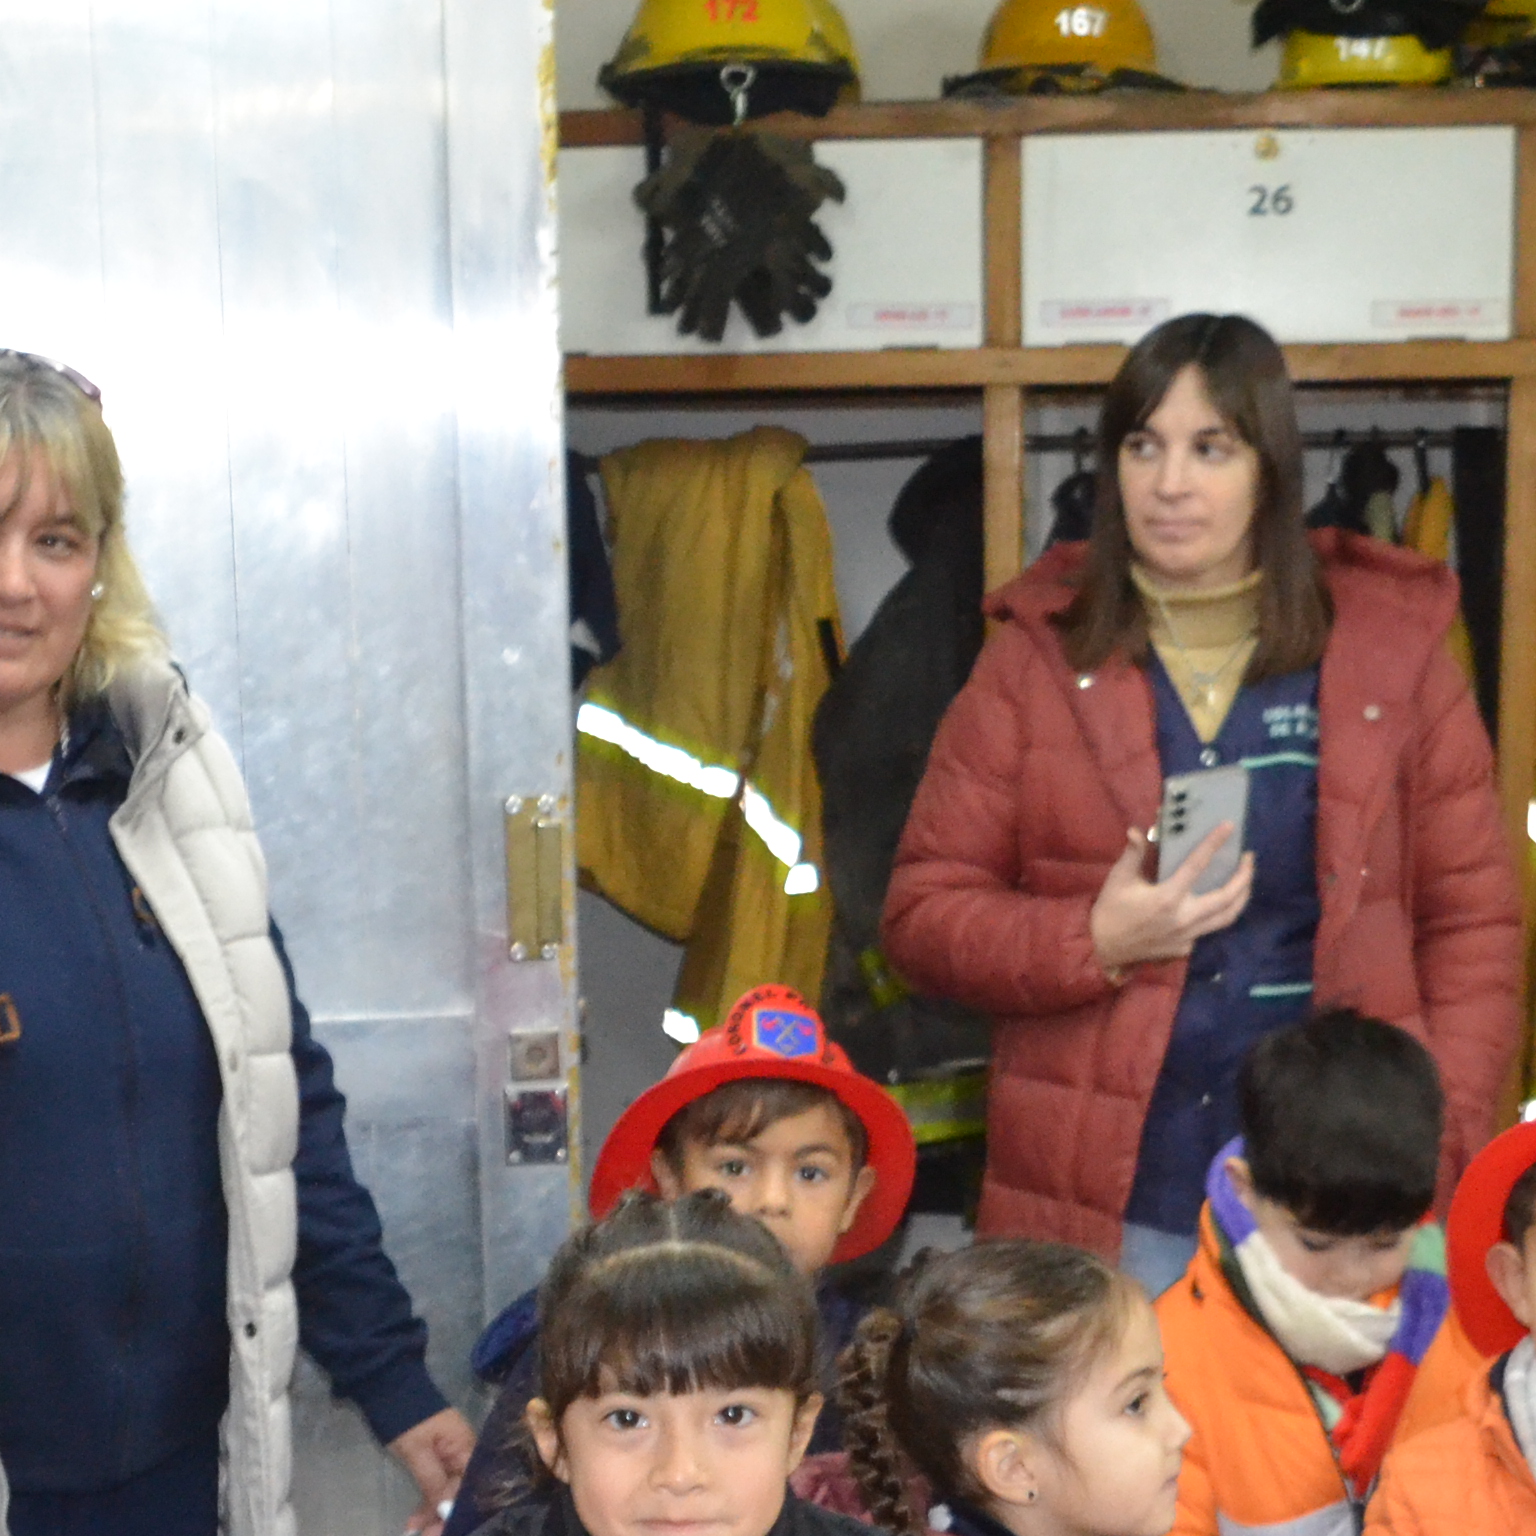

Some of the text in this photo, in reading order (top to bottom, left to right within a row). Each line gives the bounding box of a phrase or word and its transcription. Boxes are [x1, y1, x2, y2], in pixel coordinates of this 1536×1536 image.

[704, 0, 759, 22] 172
[1054, 5, 1106, 37] 167
[1247, 183, 1293, 216] 26
